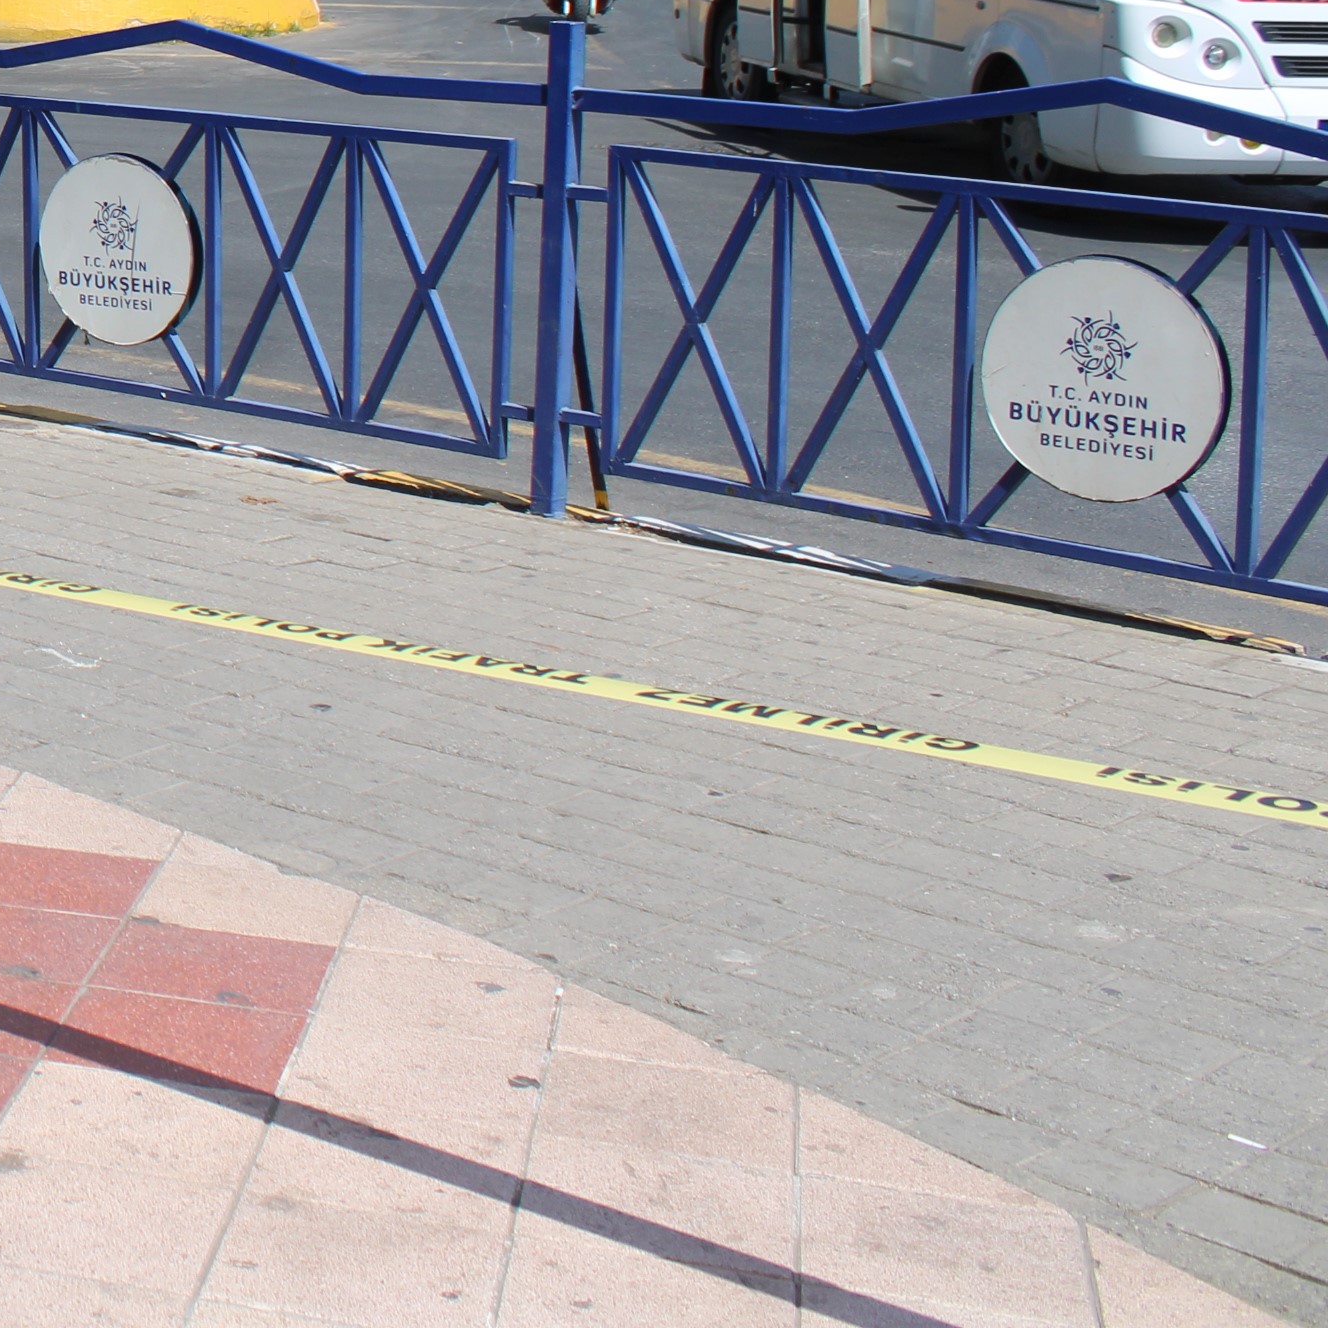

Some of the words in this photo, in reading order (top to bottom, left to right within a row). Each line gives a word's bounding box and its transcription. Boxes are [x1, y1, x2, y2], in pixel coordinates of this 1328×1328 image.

[84, 256, 105, 269] T.C.
[110, 258, 147, 272] AYDIN
[59, 269, 172, 296] BÜYÜKŞEHİR
[79, 294, 153, 312] BELEDİYESİ
[1049, 385, 1081, 401] T.C.
[1089, 391, 1148, 410] AYDIN
[1009, 401, 1187, 444] BÜYÜKŞEHİR
[1040, 433, 1154, 461] BELEDİYESİ
